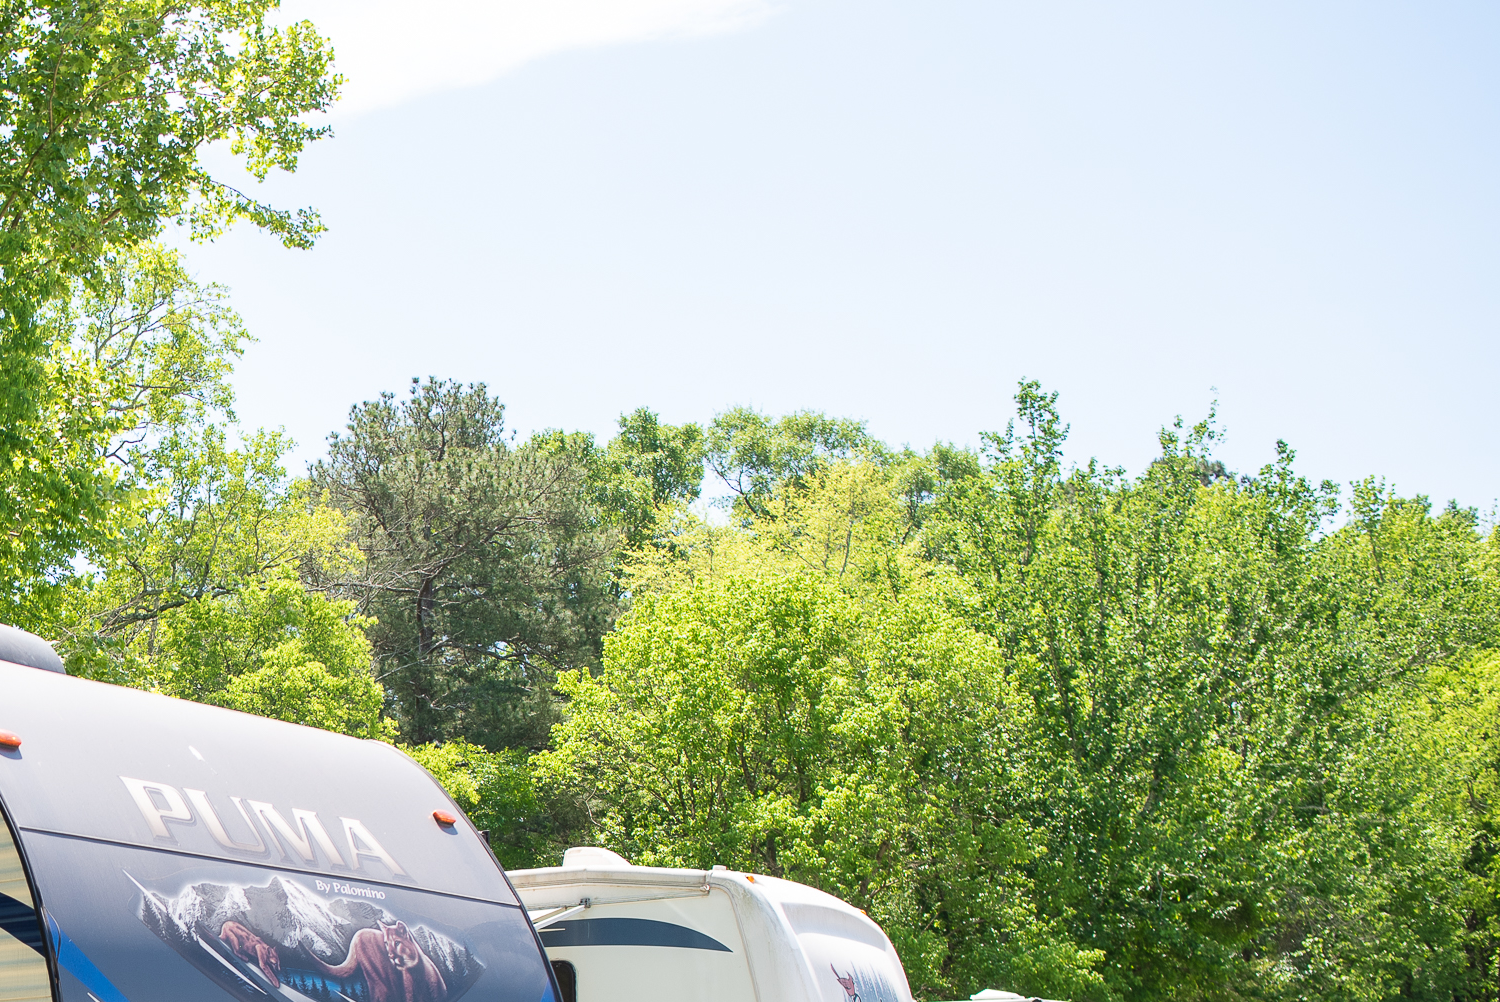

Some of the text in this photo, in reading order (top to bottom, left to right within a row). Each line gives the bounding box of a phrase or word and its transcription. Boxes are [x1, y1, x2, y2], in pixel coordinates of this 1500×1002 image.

[117, 775, 412, 881] PUMA
[315, 879, 386, 900] By Palomino
